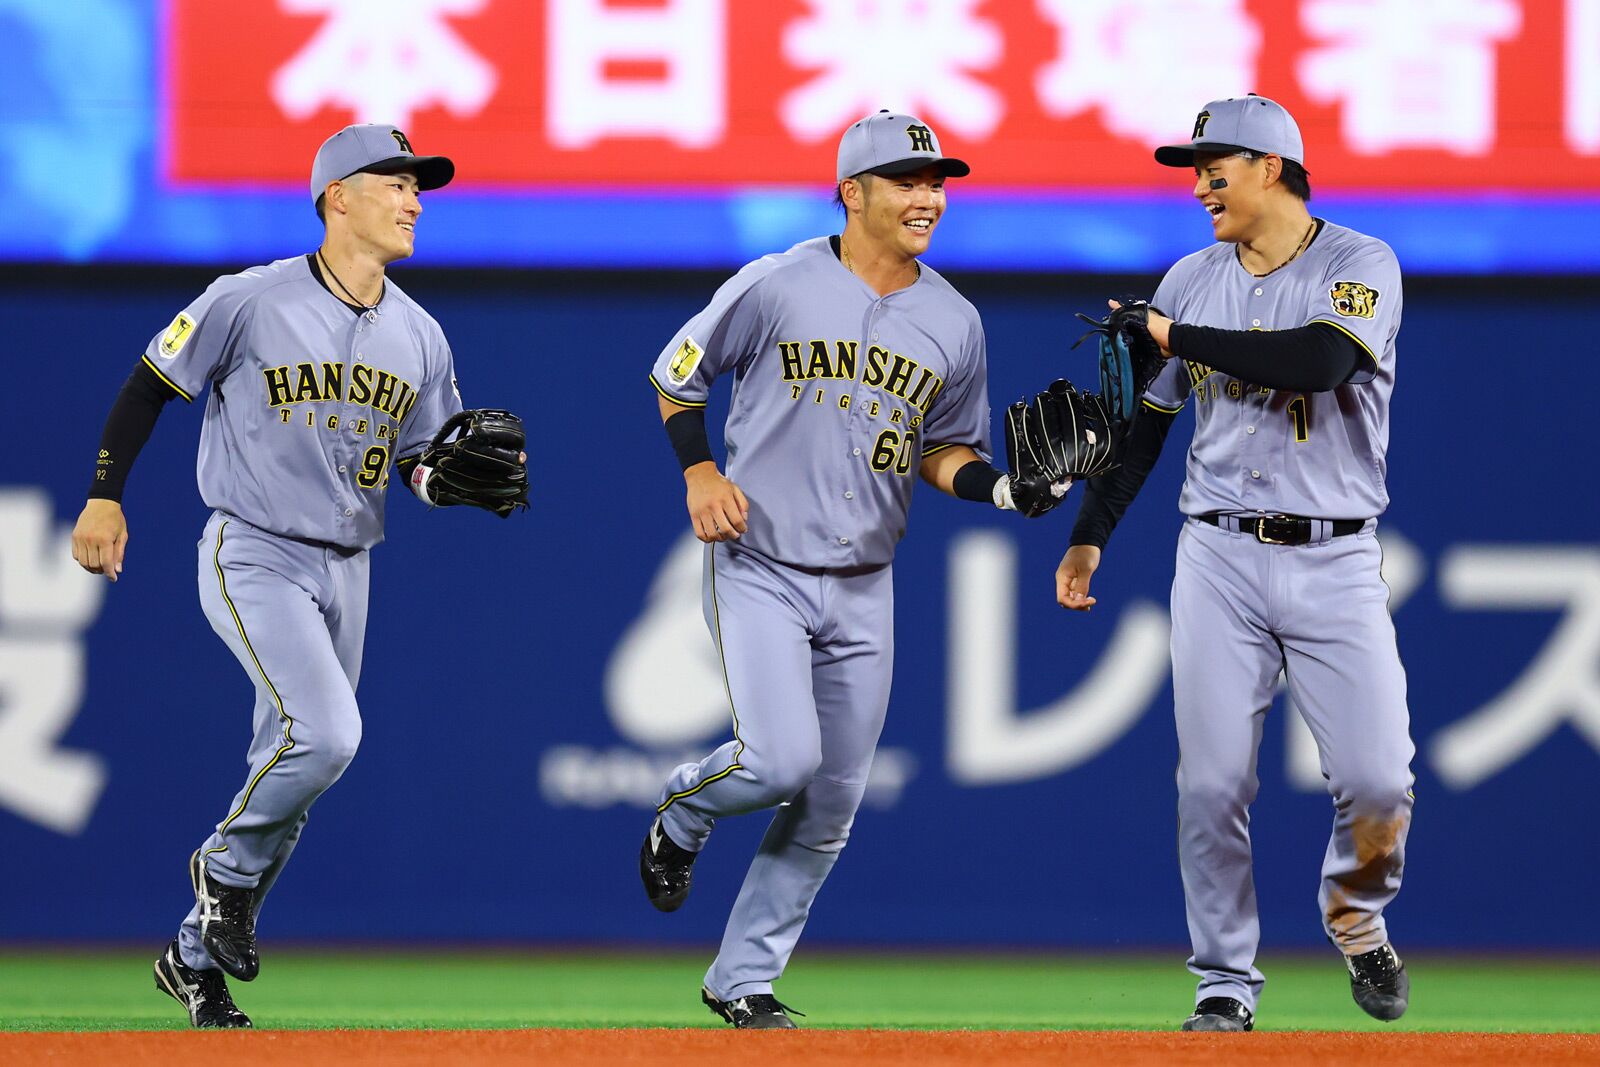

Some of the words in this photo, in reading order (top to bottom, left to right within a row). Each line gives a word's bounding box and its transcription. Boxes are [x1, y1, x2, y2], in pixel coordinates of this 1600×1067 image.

[790, 383, 924, 429] TIGERS
[1197, 380, 1272, 402] TIGE
[279, 408, 400, 442] TIGERS
[1287, 396, 1309, 443] 1
[356, 445, 390, 489] 9
[870, 428, 916, 475] 60
[96, 469, 107, 481] 92
[945, 528, 1600, 792] レス
